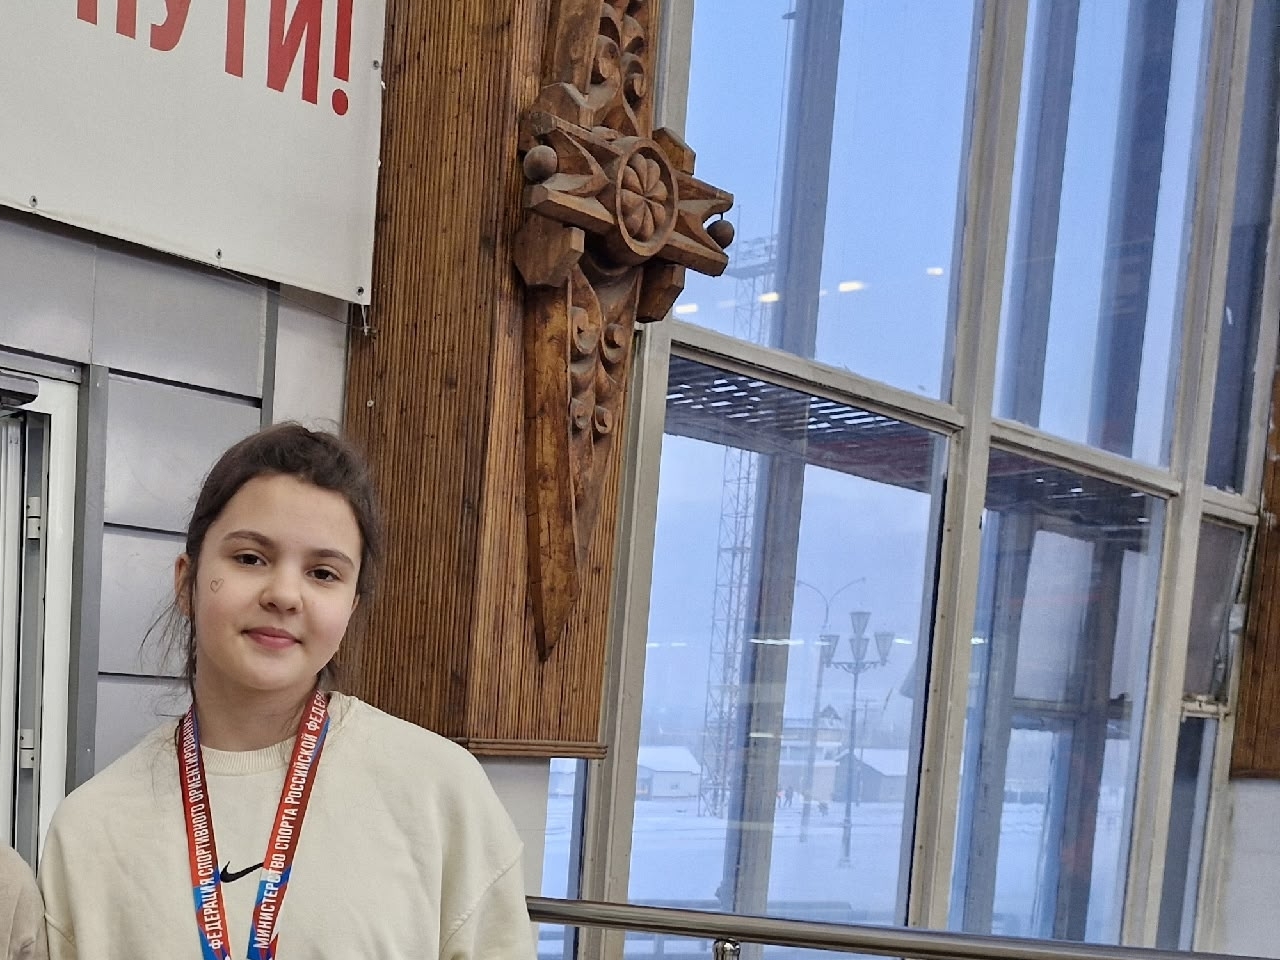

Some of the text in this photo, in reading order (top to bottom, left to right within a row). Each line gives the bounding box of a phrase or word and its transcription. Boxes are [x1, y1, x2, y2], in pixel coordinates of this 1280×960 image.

[285, 733, 318, 805] РОССИЙСКОЙ
[191, 803, 214, 877] СПОРТИВНОГО
[275, 808, 298, 850] СПОРТА
[200, 877, 223, 950] ФЕДЕРАЦИЯ
[253, 853, 286, 949] МИНИСТЕРСТВО
